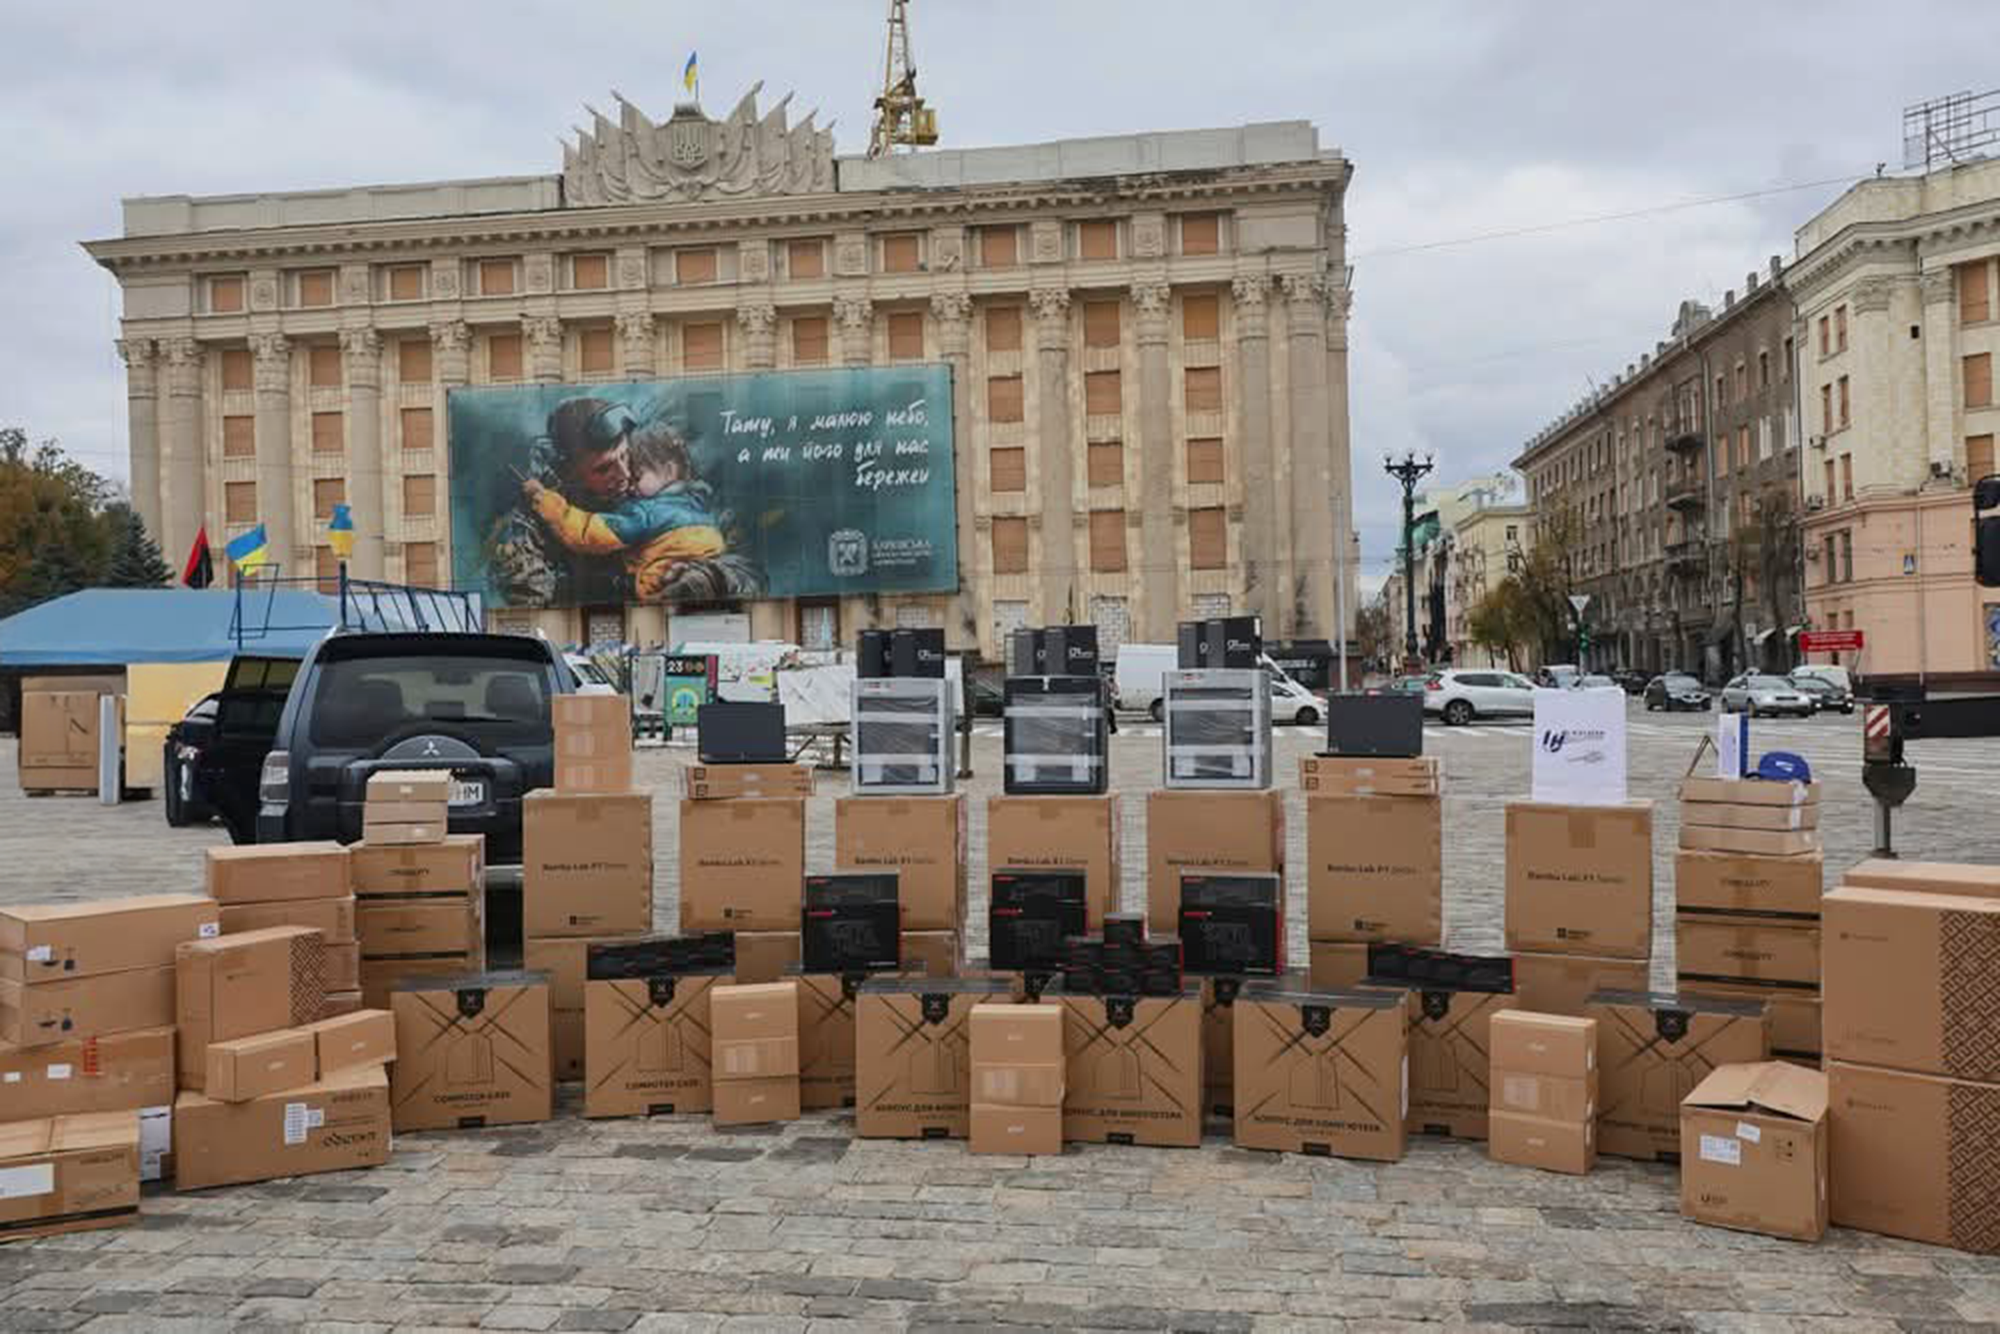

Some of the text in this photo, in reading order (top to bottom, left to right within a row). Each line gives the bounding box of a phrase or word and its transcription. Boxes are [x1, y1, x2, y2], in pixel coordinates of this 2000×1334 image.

[720, 399, 929, 438] Тату, я малюю небо,
[737, 438, 929, 463] а ти його для нас
